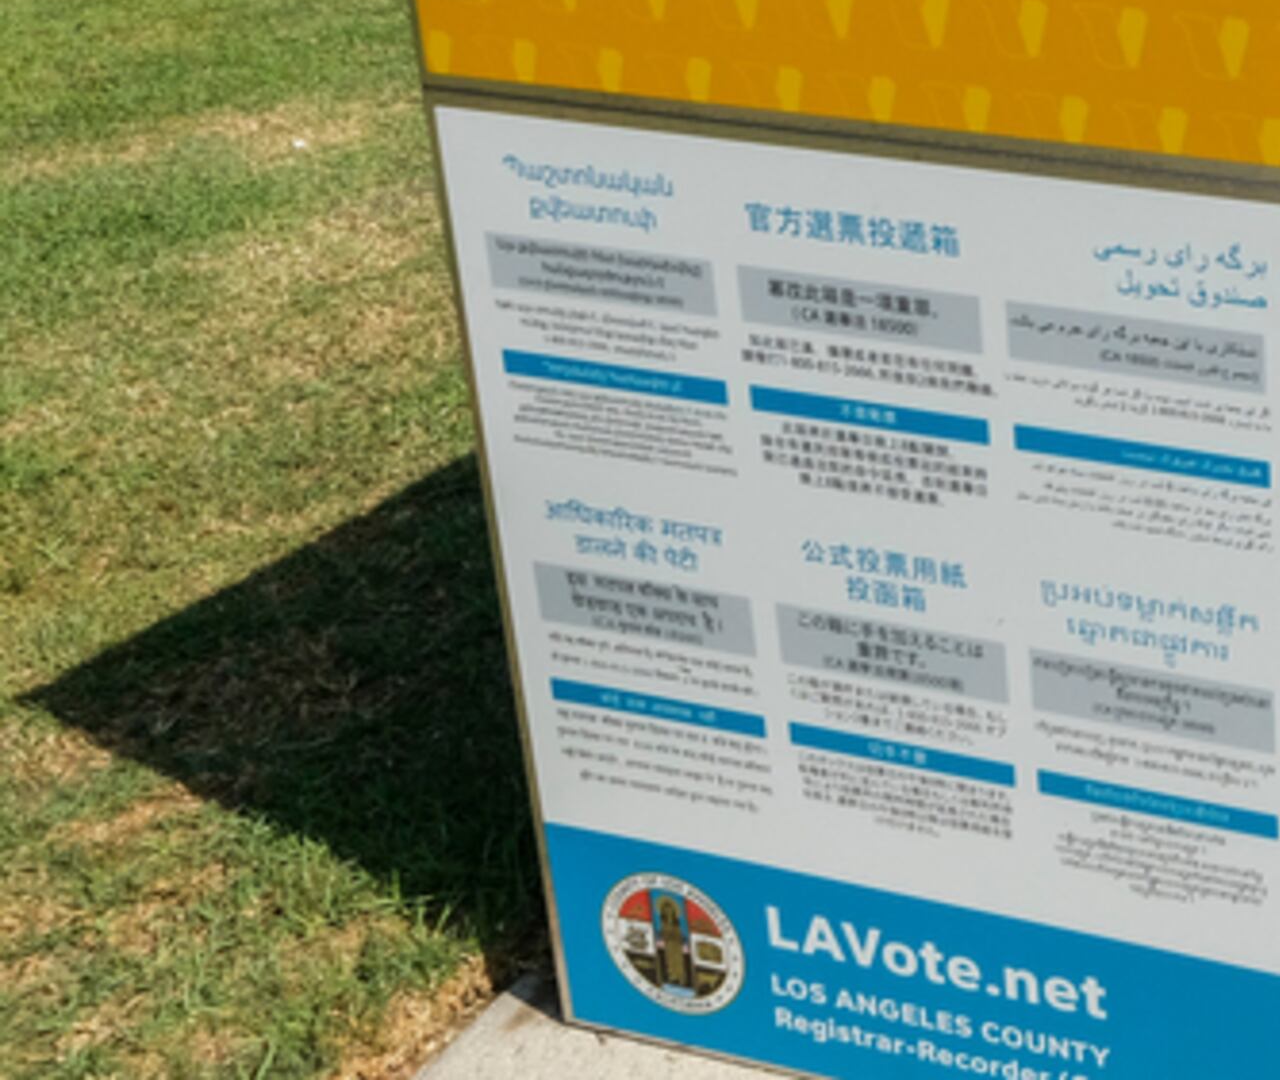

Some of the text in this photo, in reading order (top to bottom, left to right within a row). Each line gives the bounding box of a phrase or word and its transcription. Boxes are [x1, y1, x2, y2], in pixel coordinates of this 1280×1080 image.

[746, 203, 958, 255] 官方選票投遞箱
[803, 541, 965, 587] 公式投票用紙
[847, 577, 925, 611] 投函箱
[765, 904, 1108, 1021] LAVote.net
[770, 973, 1110, 1068] LOS ANGELES COUNTY
